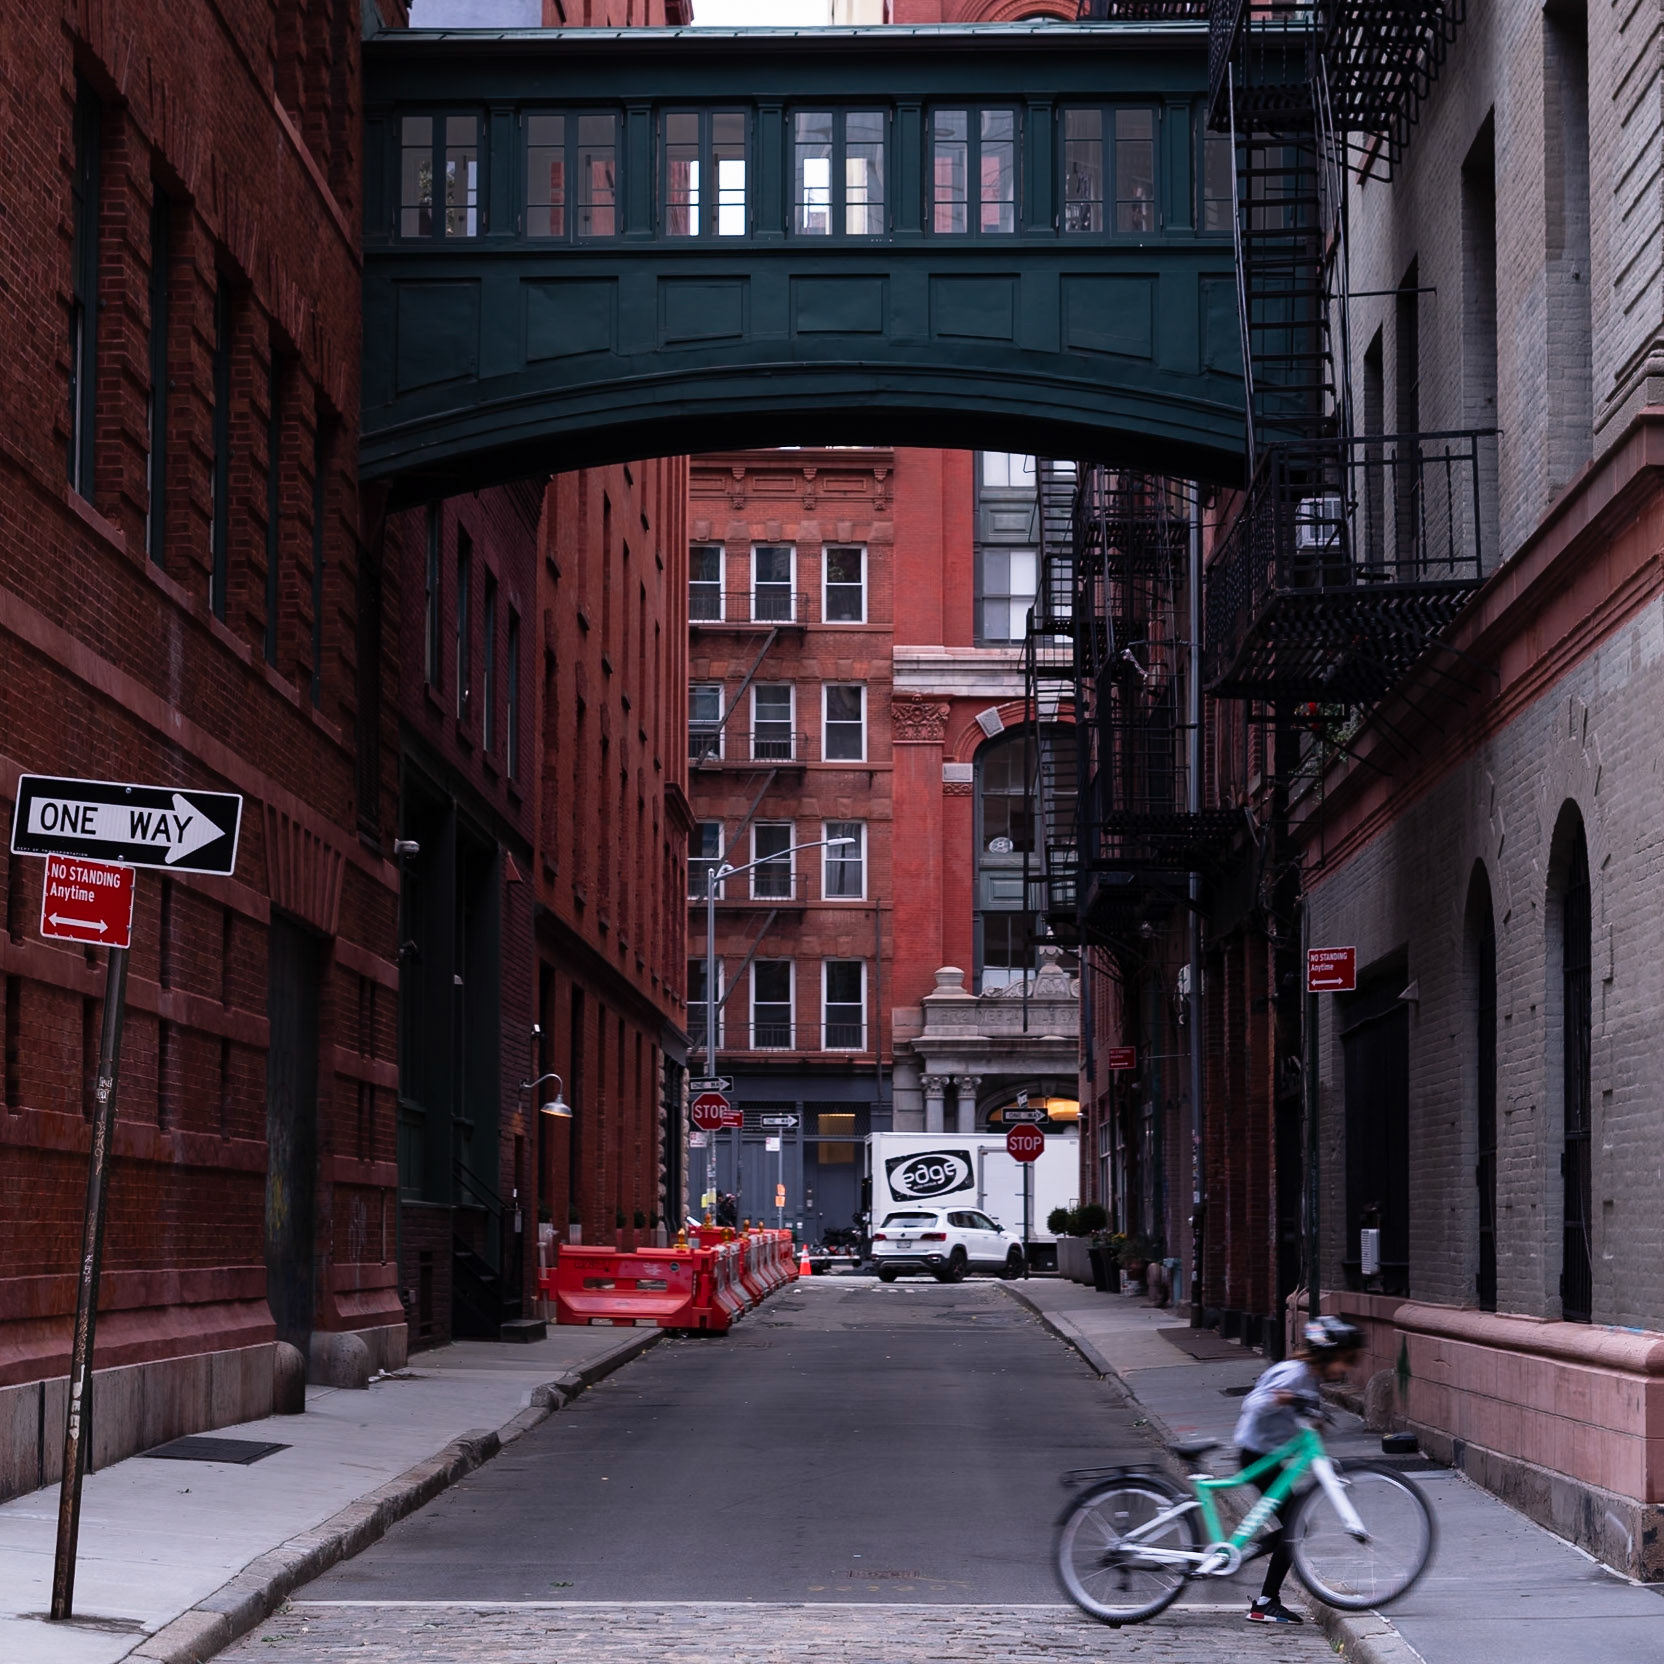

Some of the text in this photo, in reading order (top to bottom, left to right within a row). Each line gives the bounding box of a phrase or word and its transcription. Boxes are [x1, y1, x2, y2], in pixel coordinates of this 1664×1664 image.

[39, 801, 194, 844] ONE WAY
[41, 848, 88, 857] TRANSPORTATION
[51, 863, 121, 888] NO STANDING
[50, 882, 95, 902] Anytime
[1310, 952, 1348, 962] NO STANDING
[1310, 963, 1334, 973] Anytime
[694, 1104, 728, 1119] STOP
[1009, 1136, 1042, 1151] STOP
[903, 1161, 955, 1188] edge
